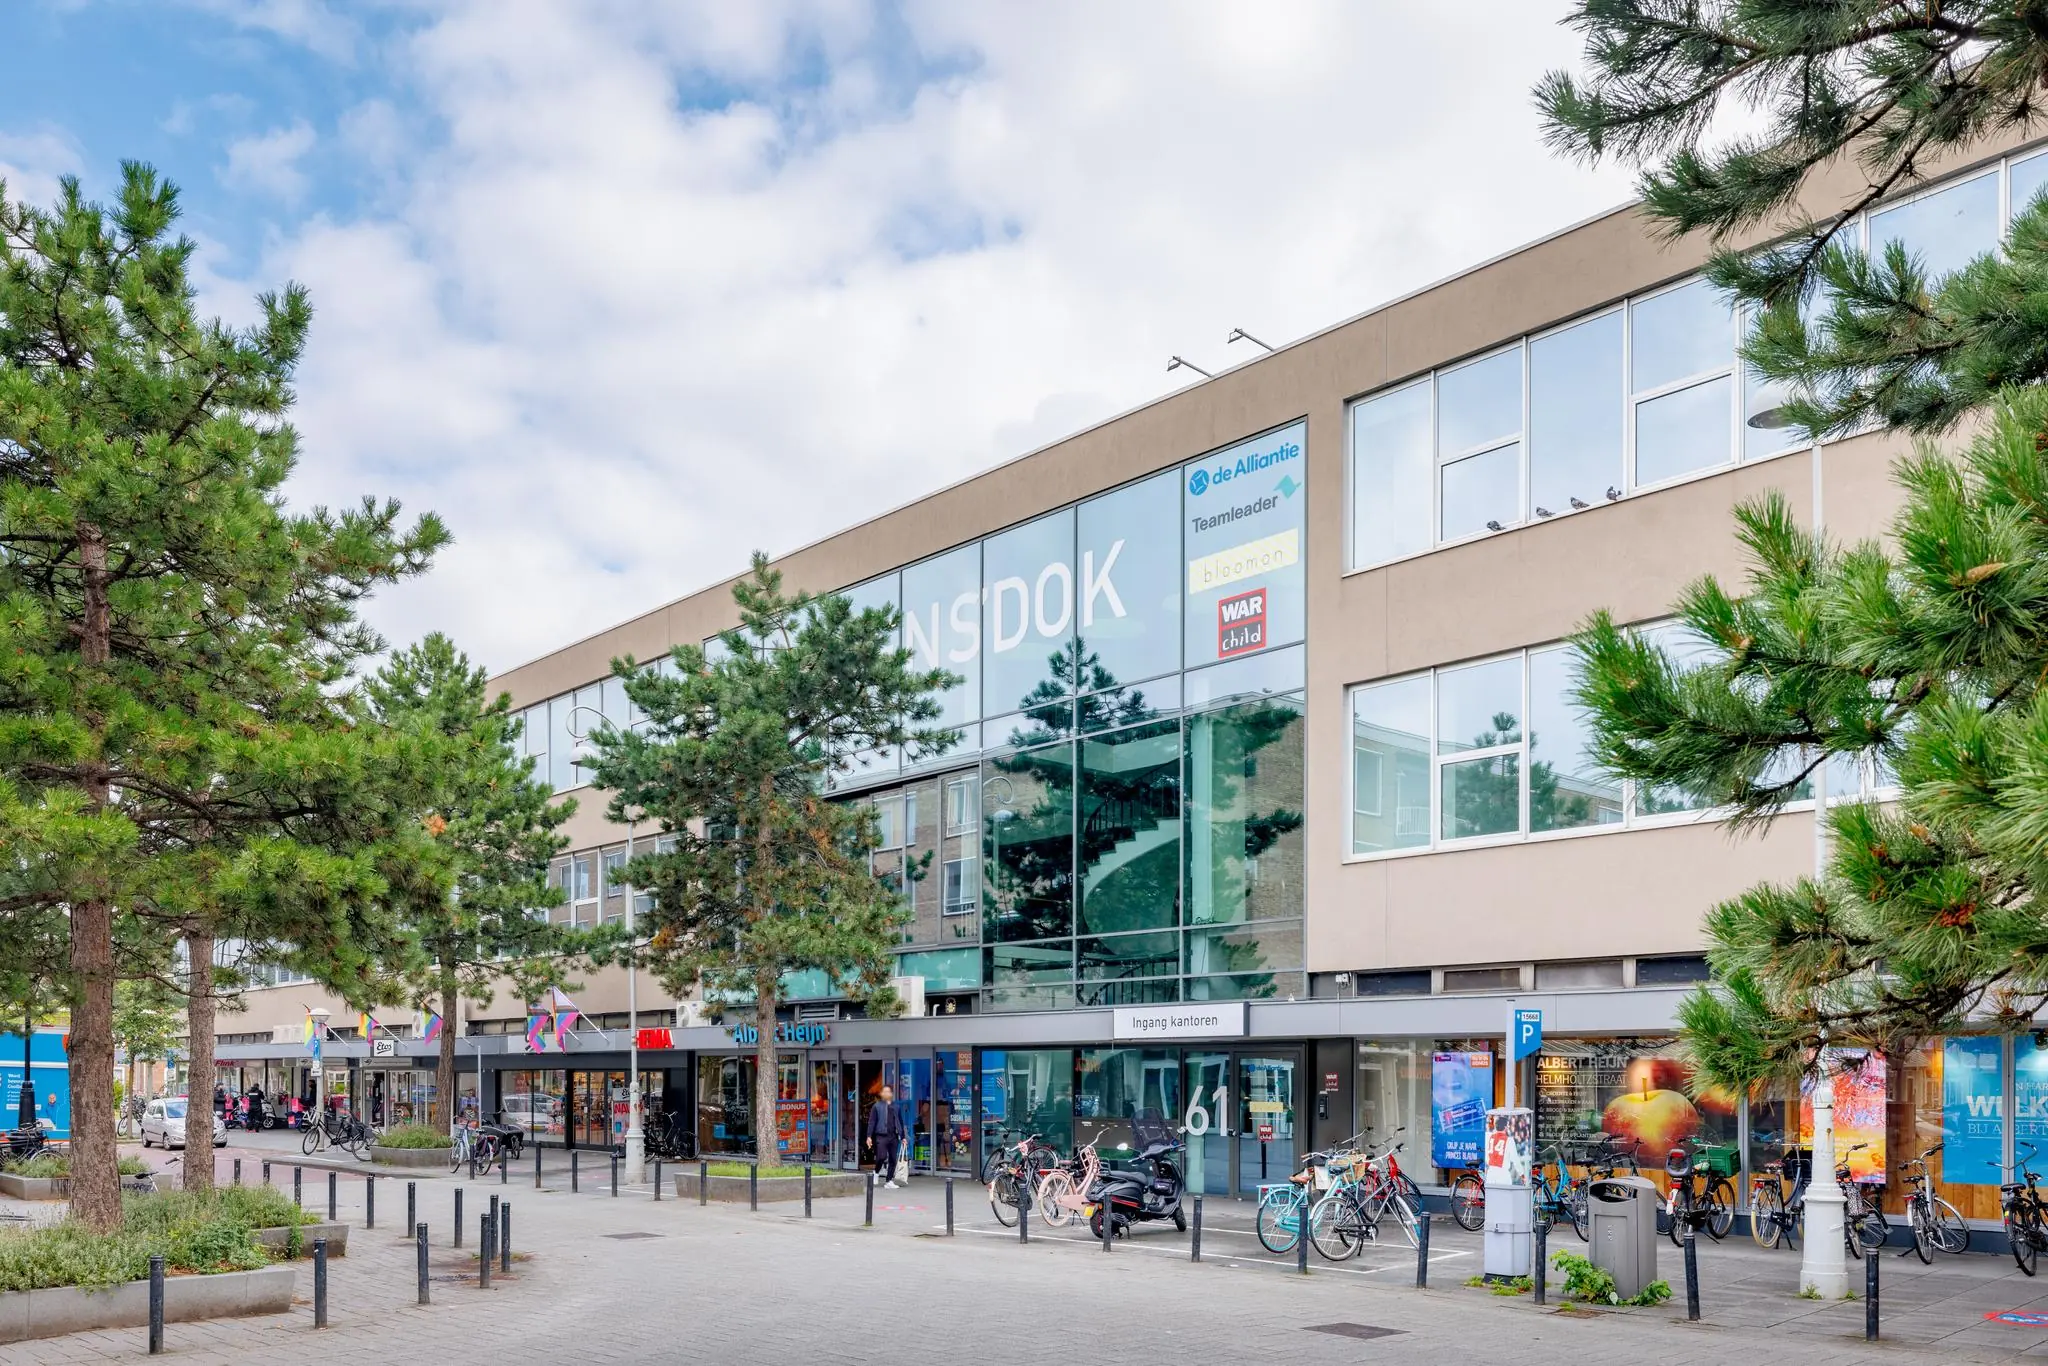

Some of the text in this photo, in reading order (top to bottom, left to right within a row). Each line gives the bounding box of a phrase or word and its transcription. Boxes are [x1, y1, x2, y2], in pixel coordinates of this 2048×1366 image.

[1212, 442, 1299, 485] de Alliantie
[1192, 495, 1278, 533] Teamleader
[1204, 550, 1283, 584] bloomon
[905, 539, 1127, 668] NSDOK
[1221, 596, 1263, 622] WAR
[1222, 624, 1261, 651] child
[782, 1020, 826, 1046] Heijn
[1132, 1015, 1218, 1031] Ingang kantoren
[1522, 1024, 1534, 1044] P
[377, 1042, 392, 1054] Etos
[1537, 1056, 1628, 1069] ALBERT HEIJN
[1536, 1074, 1628, 1085] HELMHOLTZSTRAAT
[781, 1103, 806, 1111] BONUS
[1185, 1085, 1228, 1136] 61
[1968, 1124, 1989, 1134] BIJ
[1487, 1138, 1505, 1156] 14
